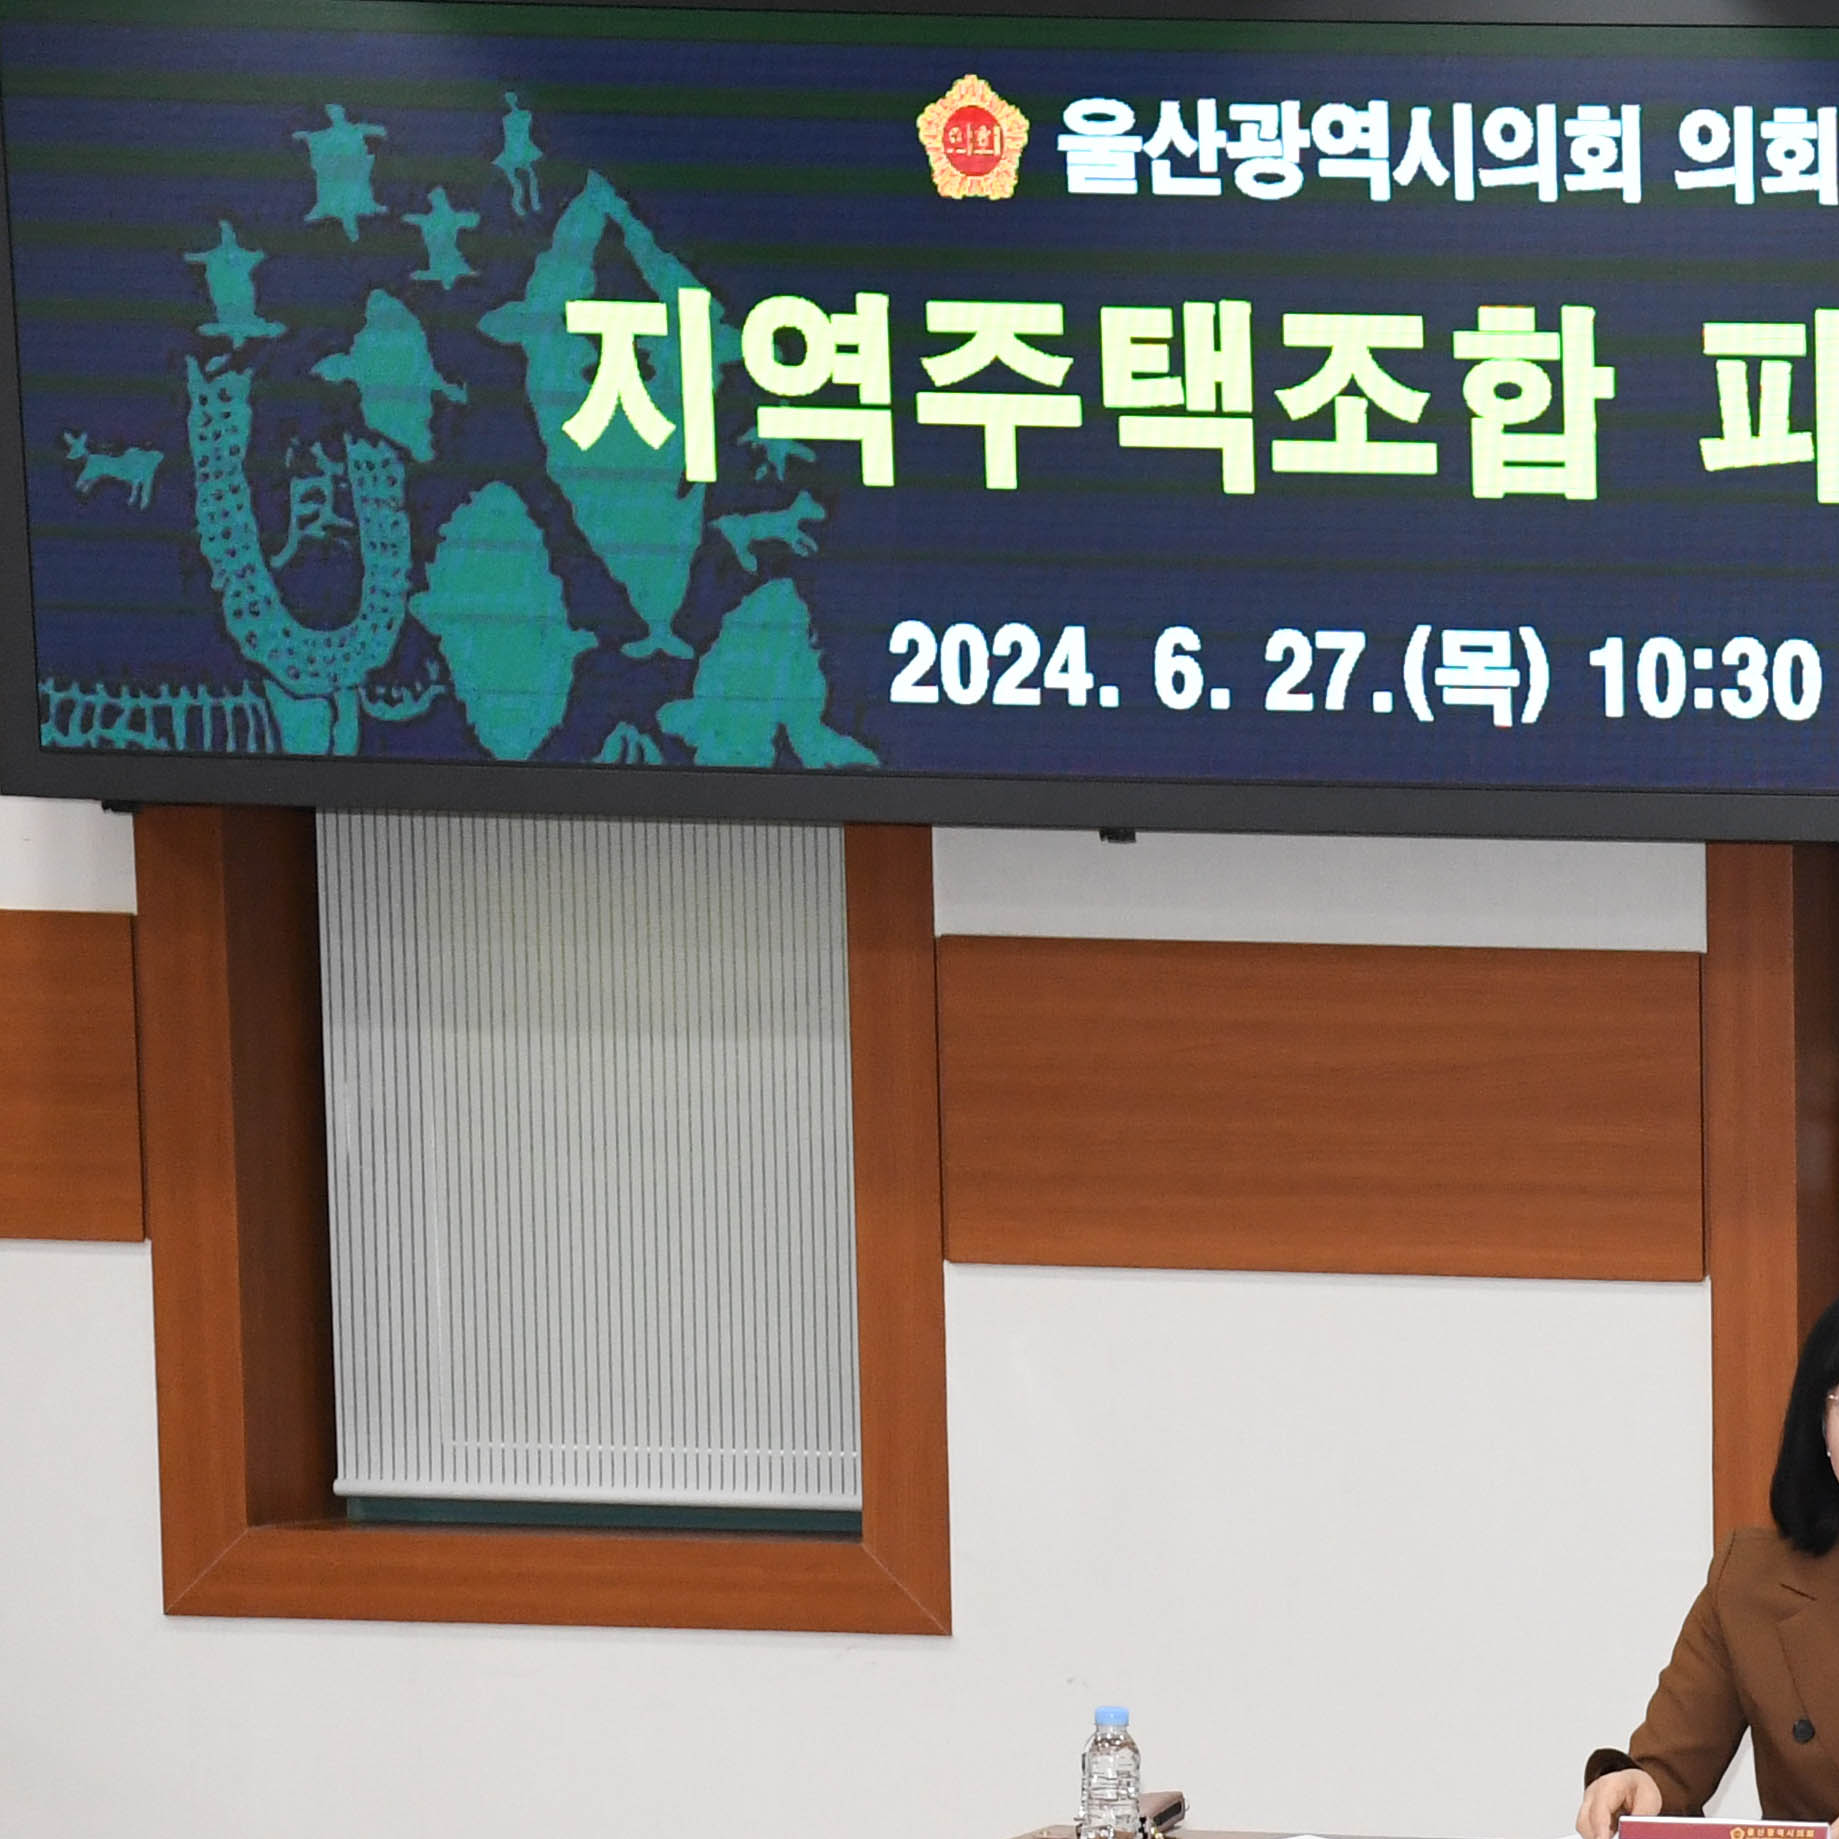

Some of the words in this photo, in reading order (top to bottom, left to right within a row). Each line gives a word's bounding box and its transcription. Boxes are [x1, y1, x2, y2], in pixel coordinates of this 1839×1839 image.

[1058, 99, 1641, 203] 울산광역시의회
[562, 288, 1614, 500] 지역주택조합
[889, 620, 1119, 707] 2024.
[1154, 626, 1230, 710] 6.
[1265, 625, 1549, 727] 27.(목)
[1589, 637, 1822, 721] 10:30
